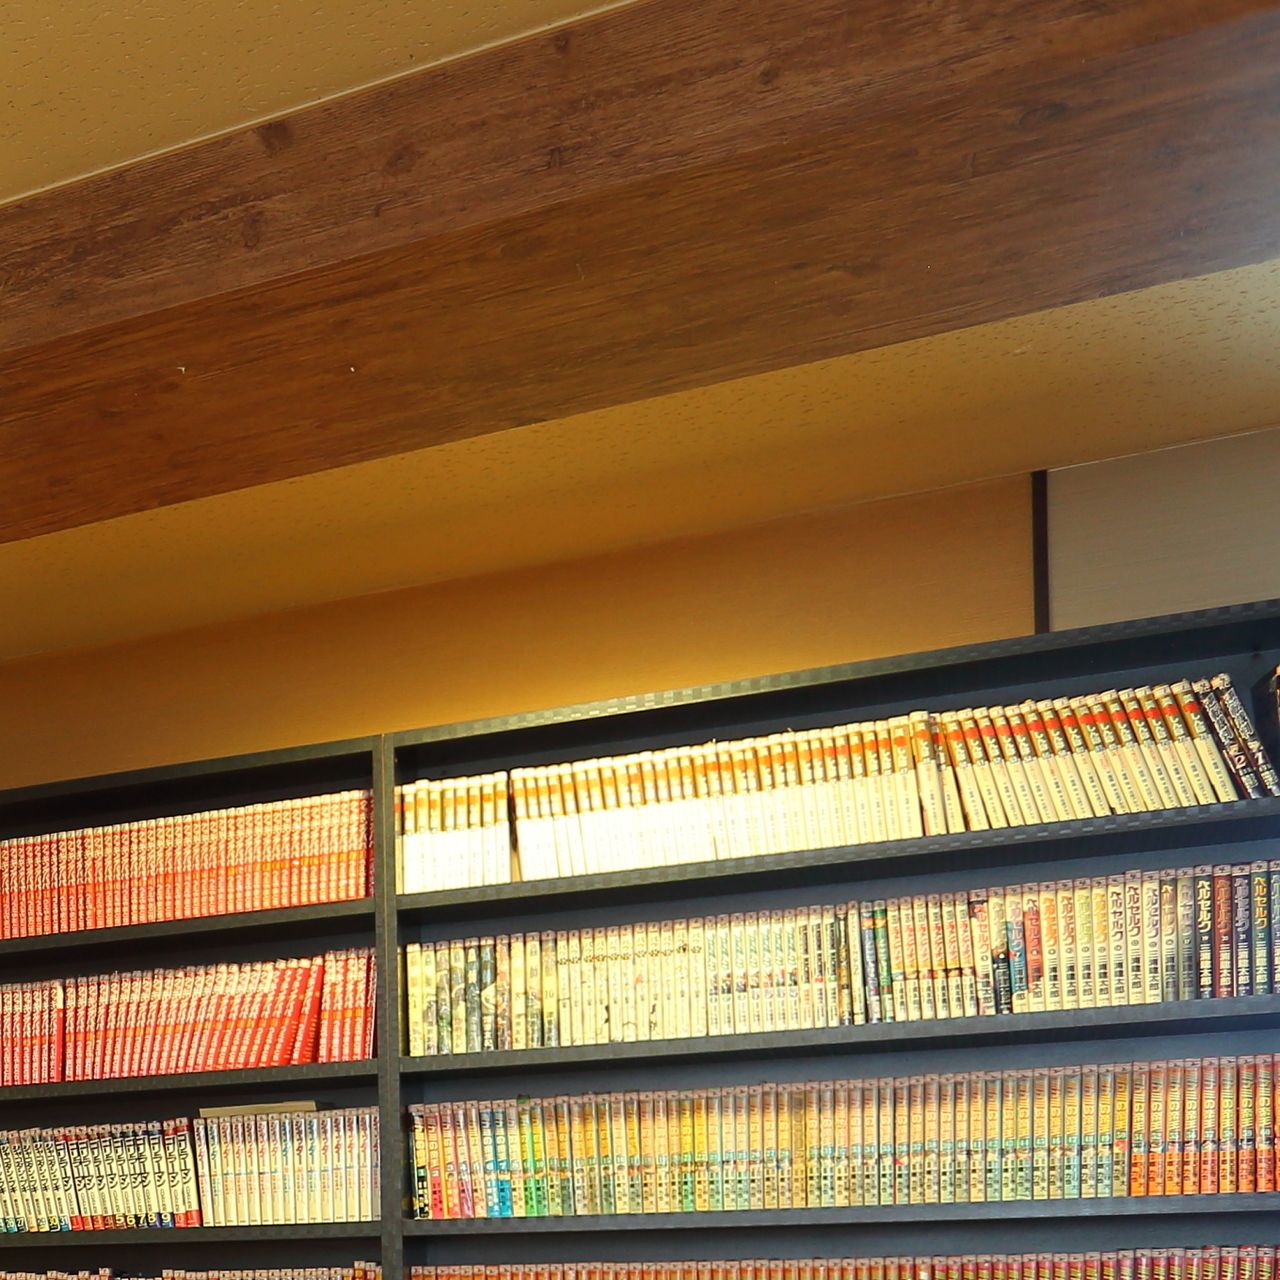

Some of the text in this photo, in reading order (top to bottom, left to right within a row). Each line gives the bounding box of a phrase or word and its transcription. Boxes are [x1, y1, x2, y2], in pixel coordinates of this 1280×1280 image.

[1196, 880, 1212, 932] ベルセルク
[1252, 877, 1268, 930] ベルセルク
[49, 1217, 58, 1225] 30
[116, 1214, 124, 1223] 5
[127, 1215, 135, 1225] 6
[138, 1214, 145, 1224] 7
[148, 1214, 156, 1223] 8
[162, 1213, 170, 1222] 9
